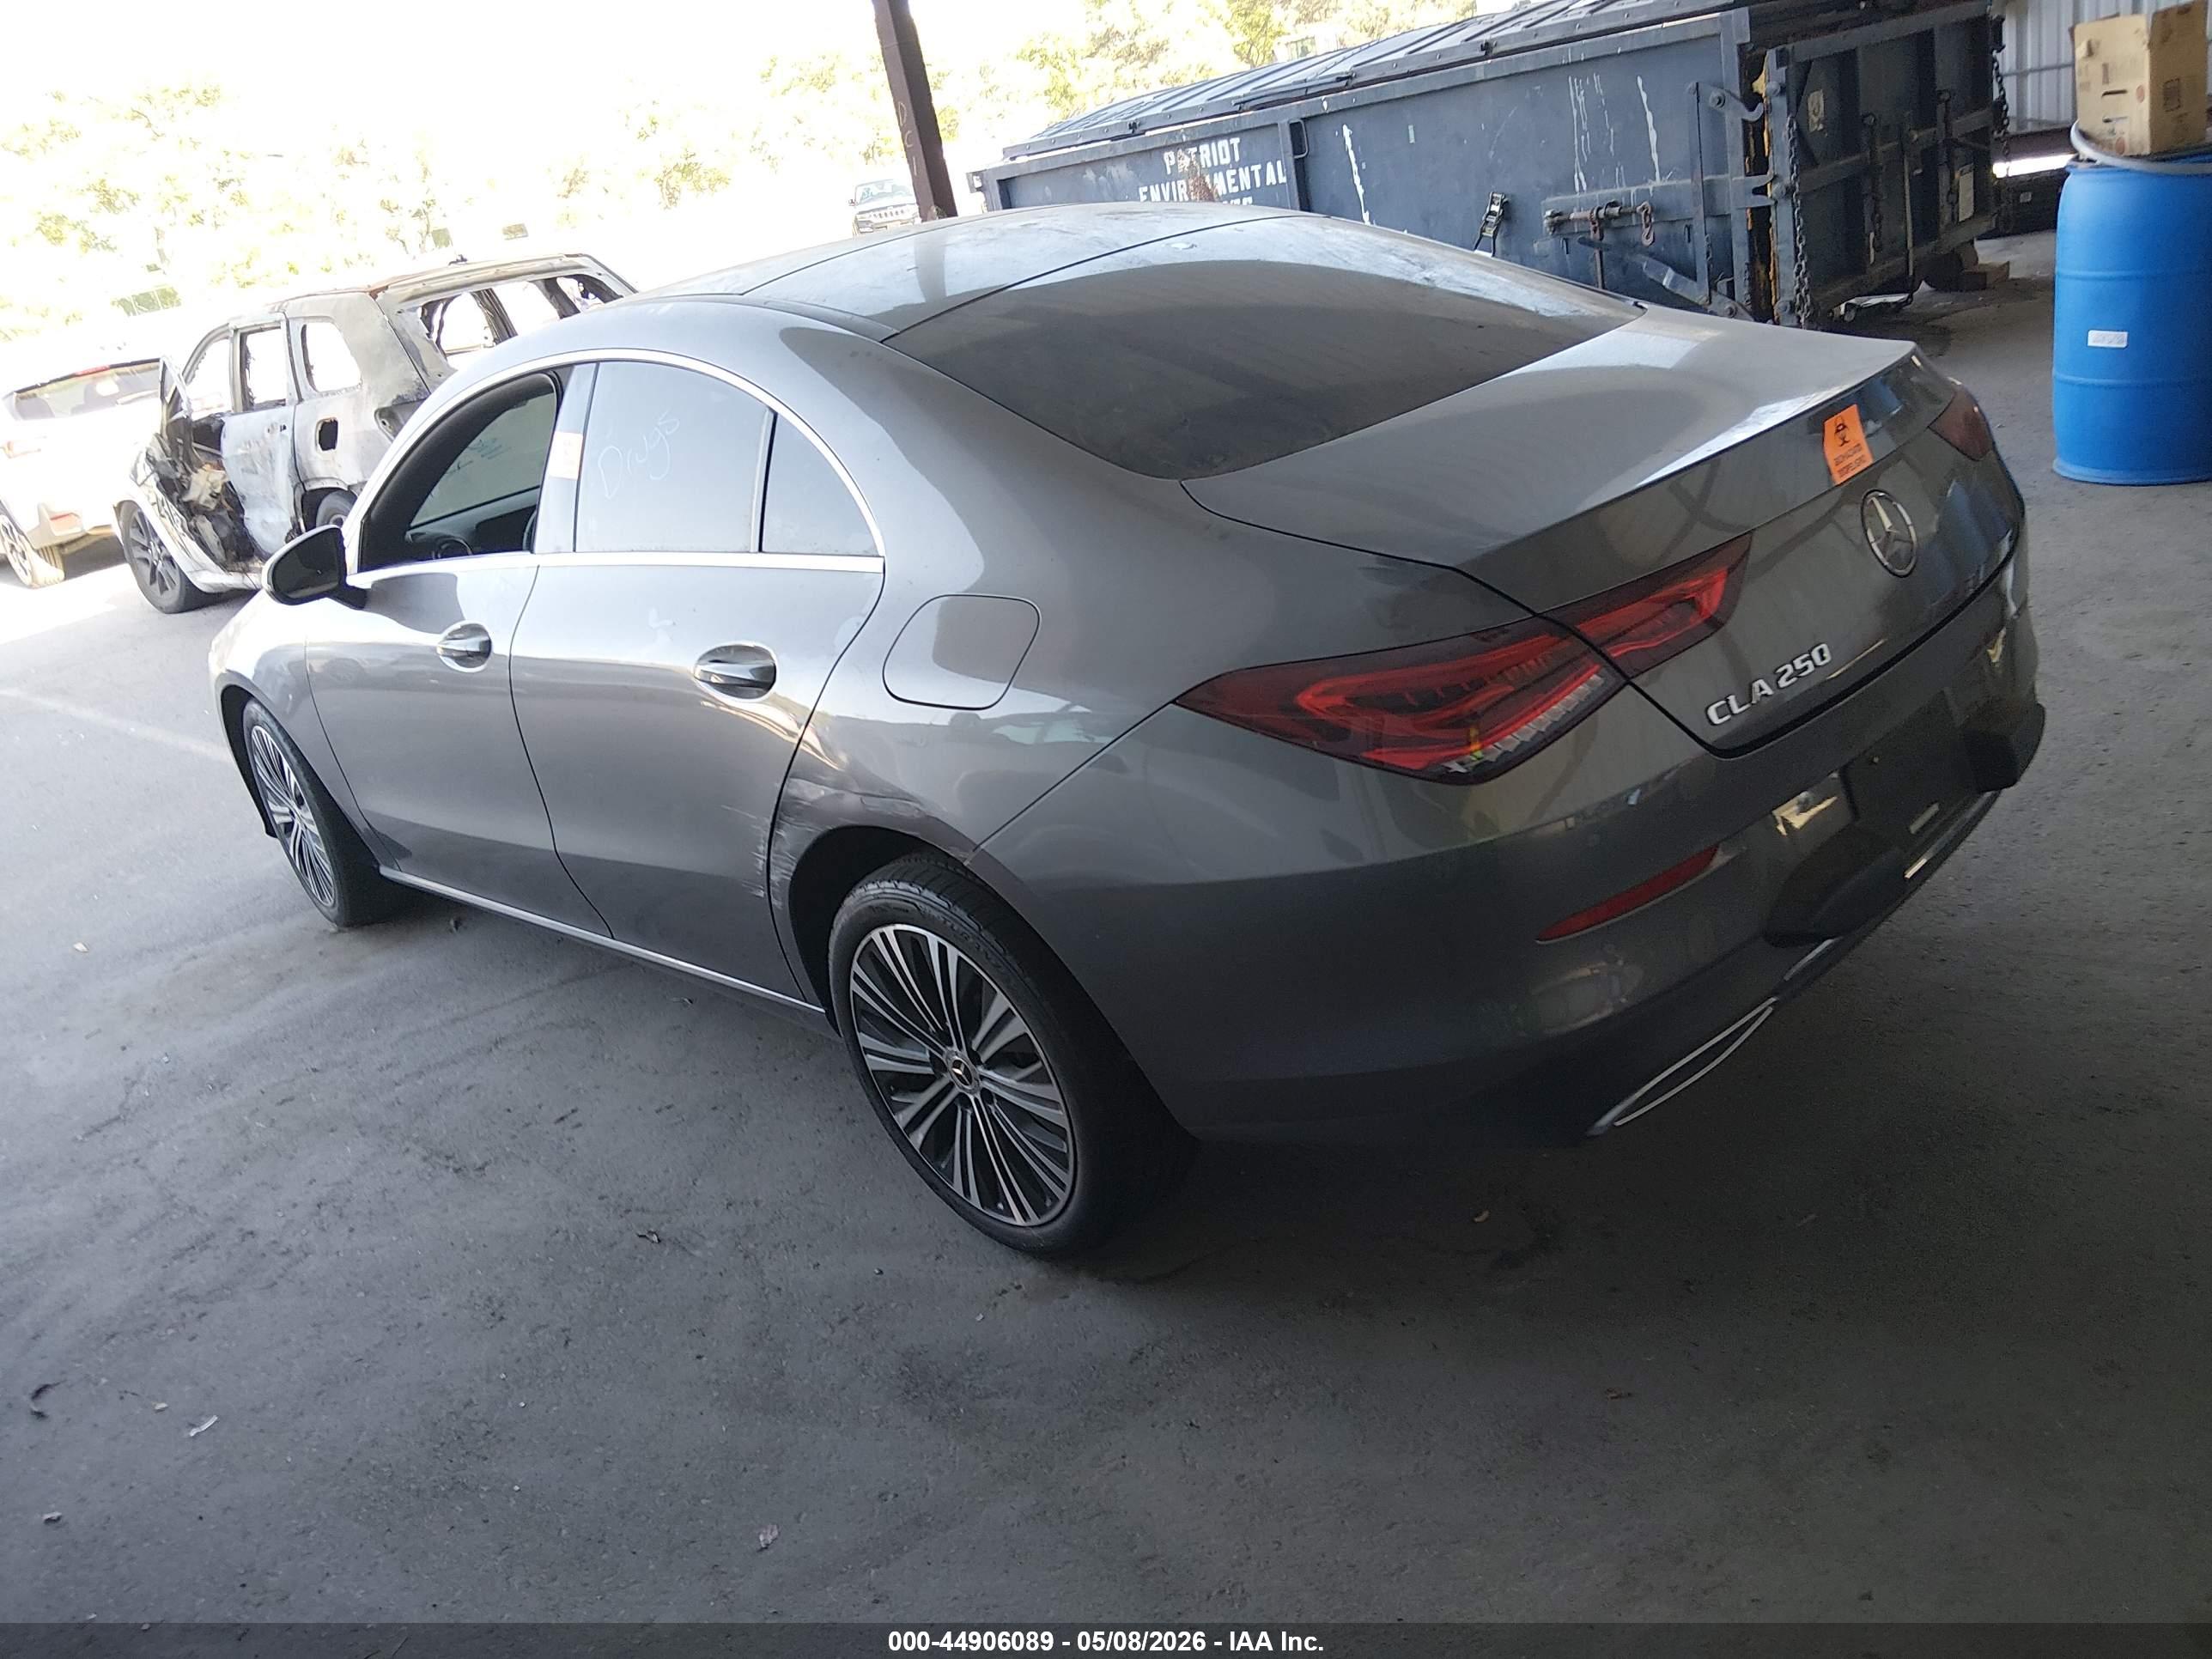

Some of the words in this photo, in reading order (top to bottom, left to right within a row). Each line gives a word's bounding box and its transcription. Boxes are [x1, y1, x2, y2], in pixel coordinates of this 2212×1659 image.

[1163, 137, 1241, 175] PATRIOT
[1139, 159, 1287, 203] ENVIRMENTAL
[1705, 678, 1775, 726] CLA
[1774, 642, 1832, 689] 250
